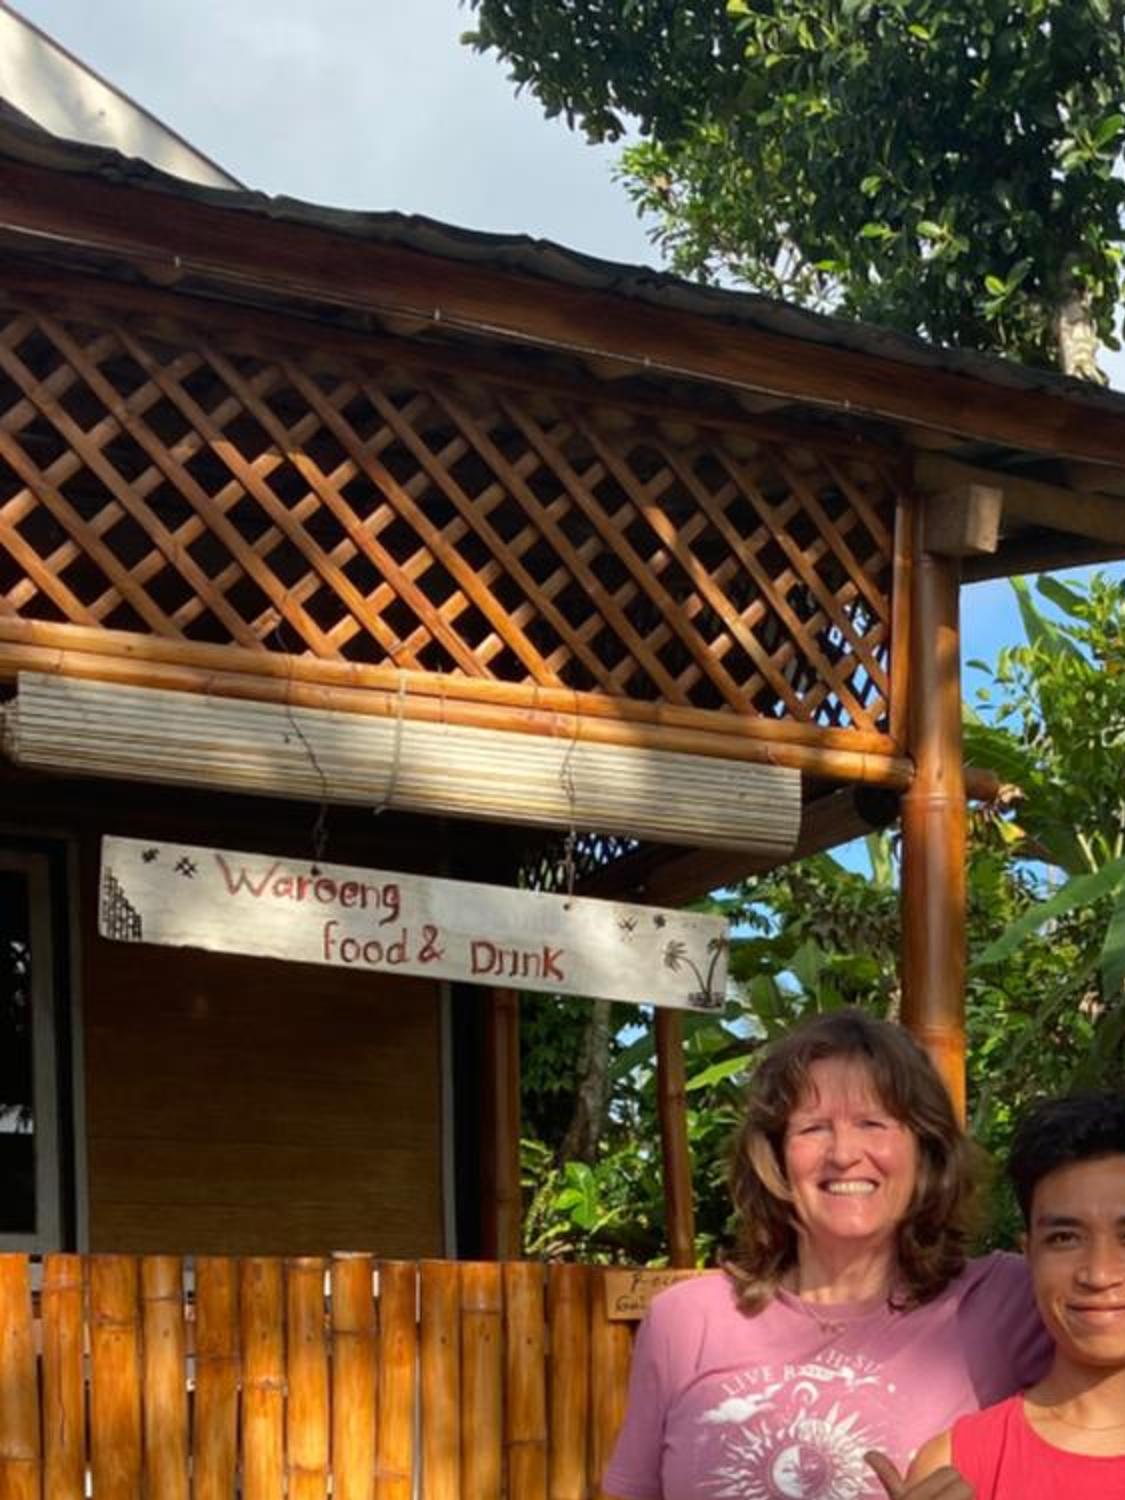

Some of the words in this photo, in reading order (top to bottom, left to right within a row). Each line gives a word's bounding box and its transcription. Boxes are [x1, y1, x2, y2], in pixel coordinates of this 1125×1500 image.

[214, 854, 401, 925] Waroeng
[417, 924, 445, 964] &
[721, 1365, 774, 1396] LIVE
